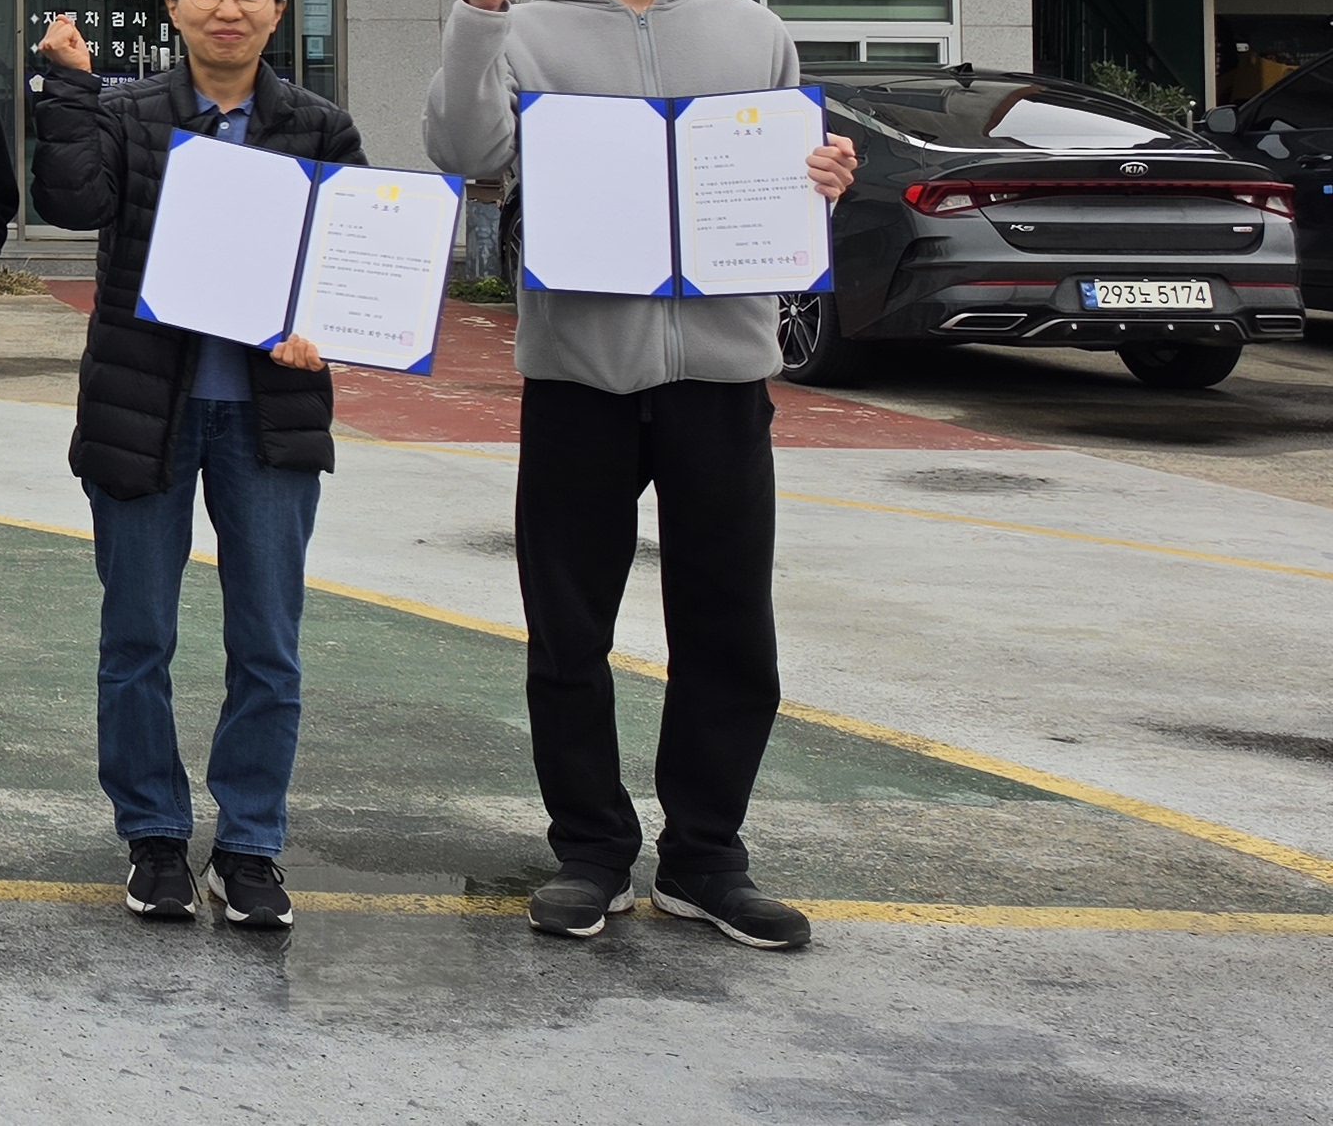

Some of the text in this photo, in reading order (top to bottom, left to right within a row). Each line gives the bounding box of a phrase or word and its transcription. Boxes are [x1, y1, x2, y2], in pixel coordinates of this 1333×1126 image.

[112, 11, 147, 27] 검사
[1125, 165, 1144, 174] KIA
[1098, 285, 1207, 304] 293노 5174
